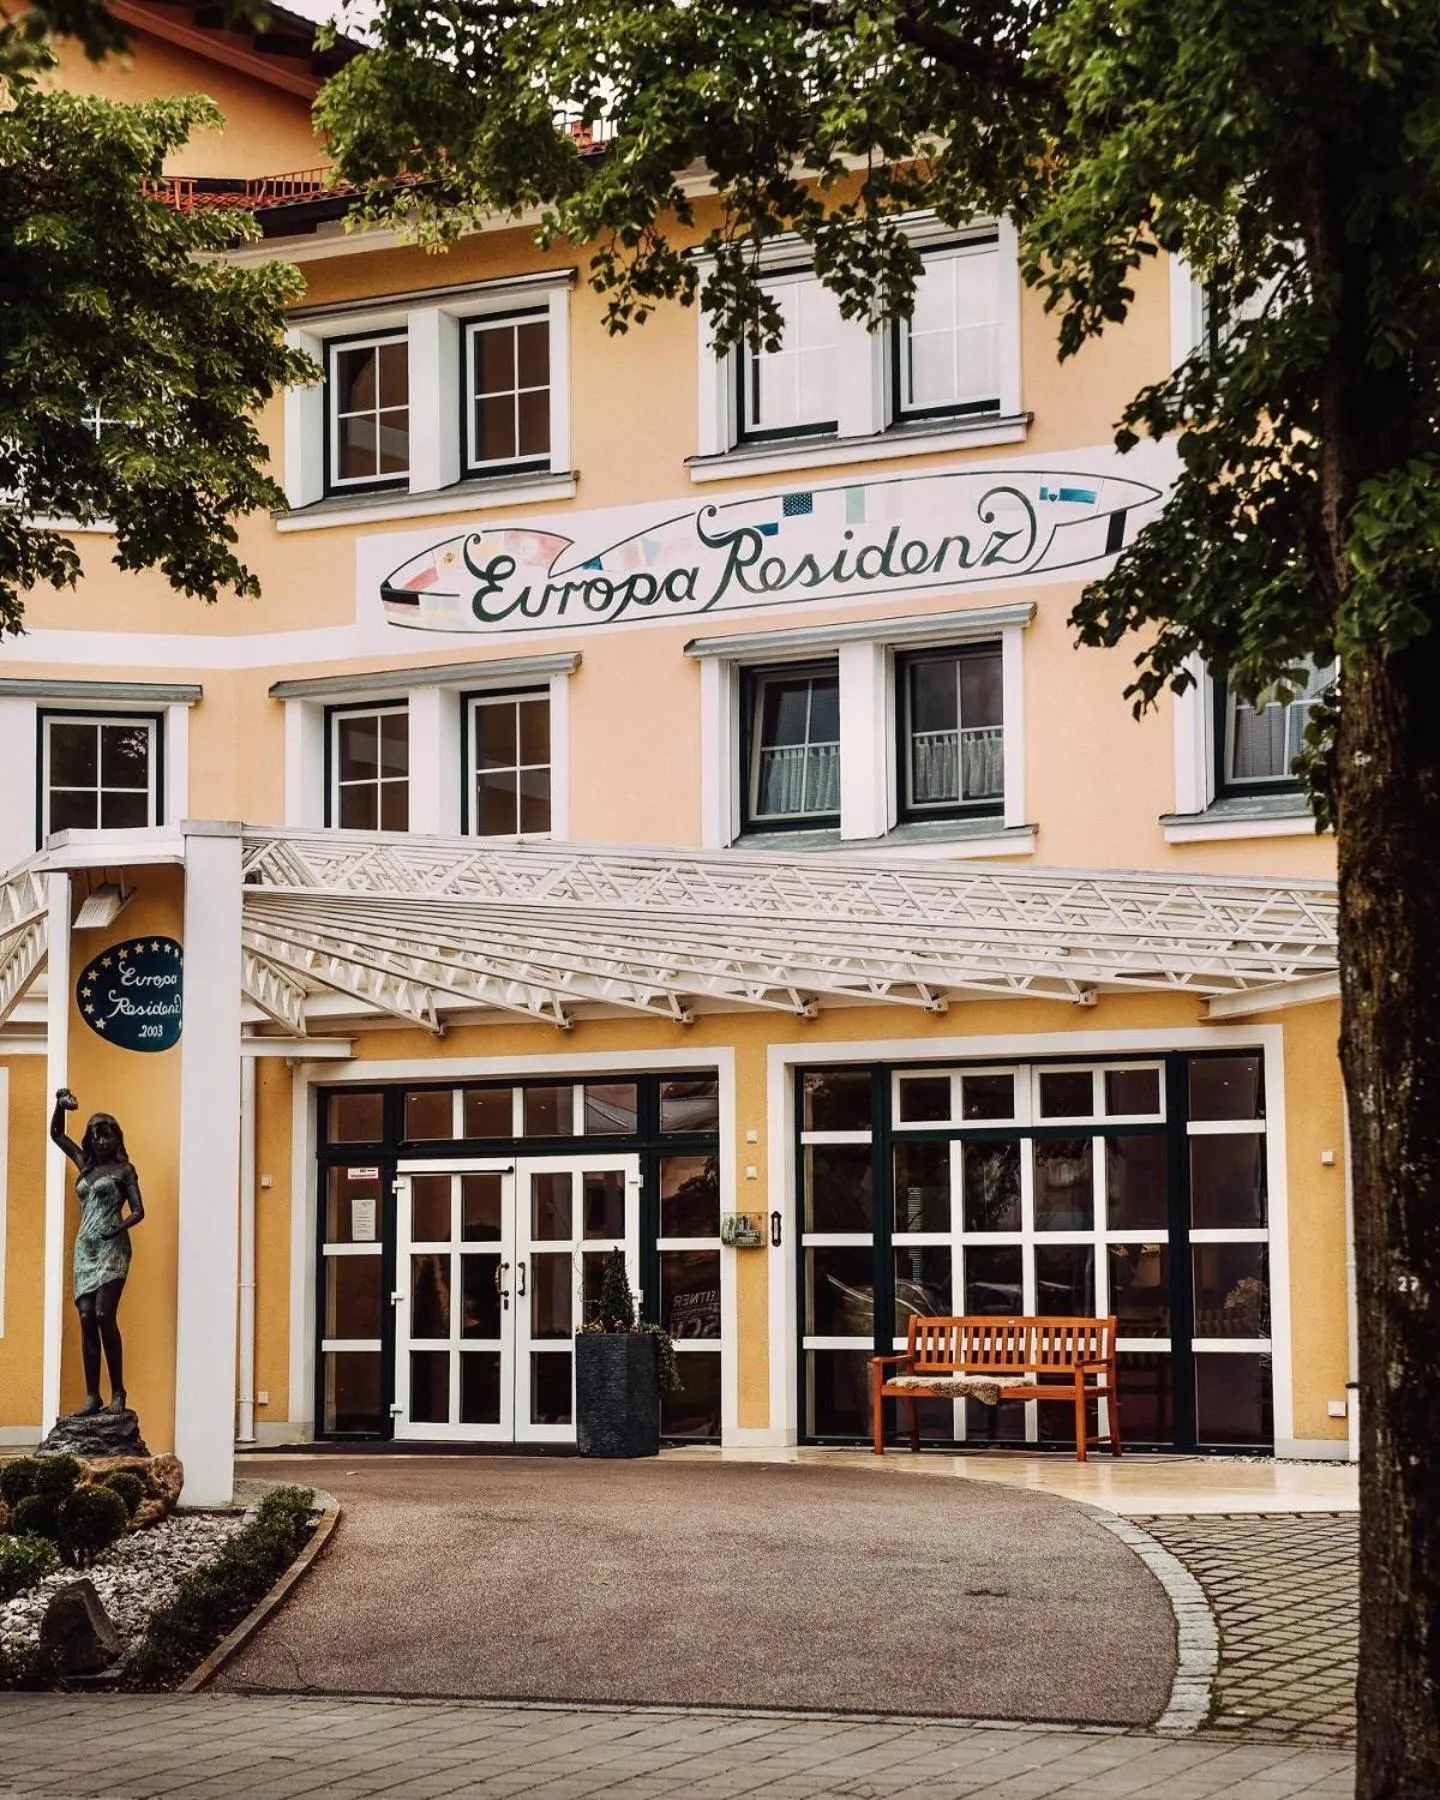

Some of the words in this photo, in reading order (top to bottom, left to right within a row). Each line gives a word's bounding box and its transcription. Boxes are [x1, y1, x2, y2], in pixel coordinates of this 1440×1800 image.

[463, 533, 700, 623] Europa
[697, 483, 1036, 611] Residenz
[119, 961, 177, 988] Europa
[138, 1025, 163, 1038] 2003
